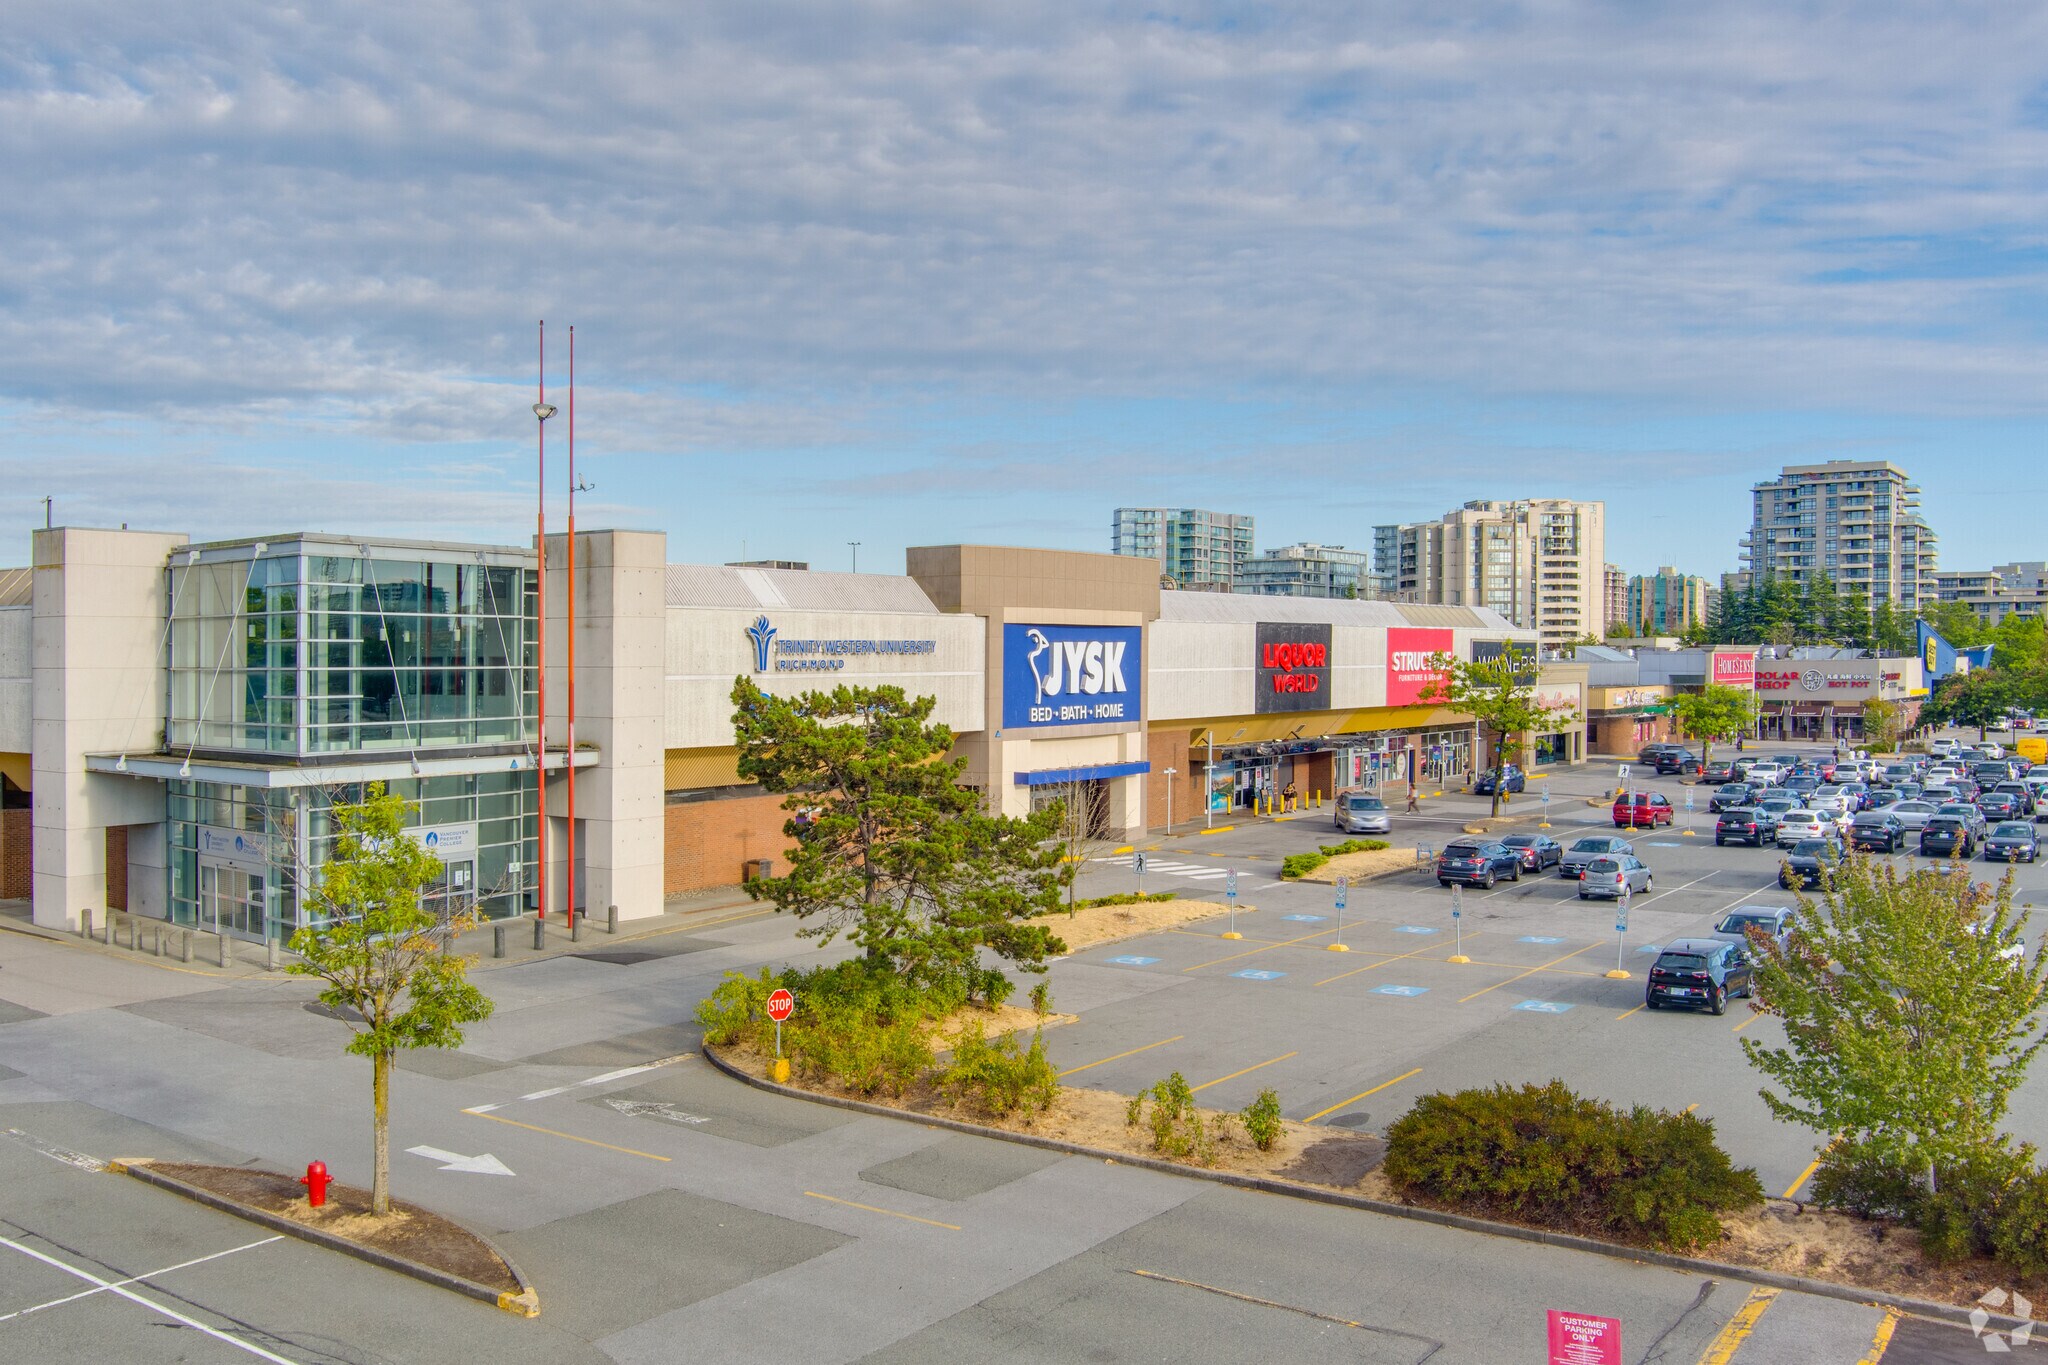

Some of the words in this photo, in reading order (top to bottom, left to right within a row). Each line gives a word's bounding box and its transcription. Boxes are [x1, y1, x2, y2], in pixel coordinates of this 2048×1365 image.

[778, 640, 822, 654] TRINITY
[825, 640, 876, 654] WESTERN
[880, 640, 937, 654] UNIVERSITY
[1263, 642, 1326, 672] LIQUOR
[1392, 651, 1452, 672] STRUCTE
[780, 659, 845, 670] RICHMOND
[1042, 641, 1127, 696] JYSK
[1398, 674, 1423, 682] FURNITURE
[1755, 671, 1799, 680] DOLAR
[1273, 674, 1319, 693] WORLD
[1755, 681, 1791, 689] SHOP
[1030, 707, 1053, 722] BED
[1061, 705, 1087, 720] BATH
[1095, 704, 1124, 719] HOME
[770, 998, 791, 1012] STOP
[1560, 1316, 1608, 1330] CUSTOMER
[1564, 1324, 1603, 1337] PARKING
[1572, 1333, 1596, 1343] ONLY
